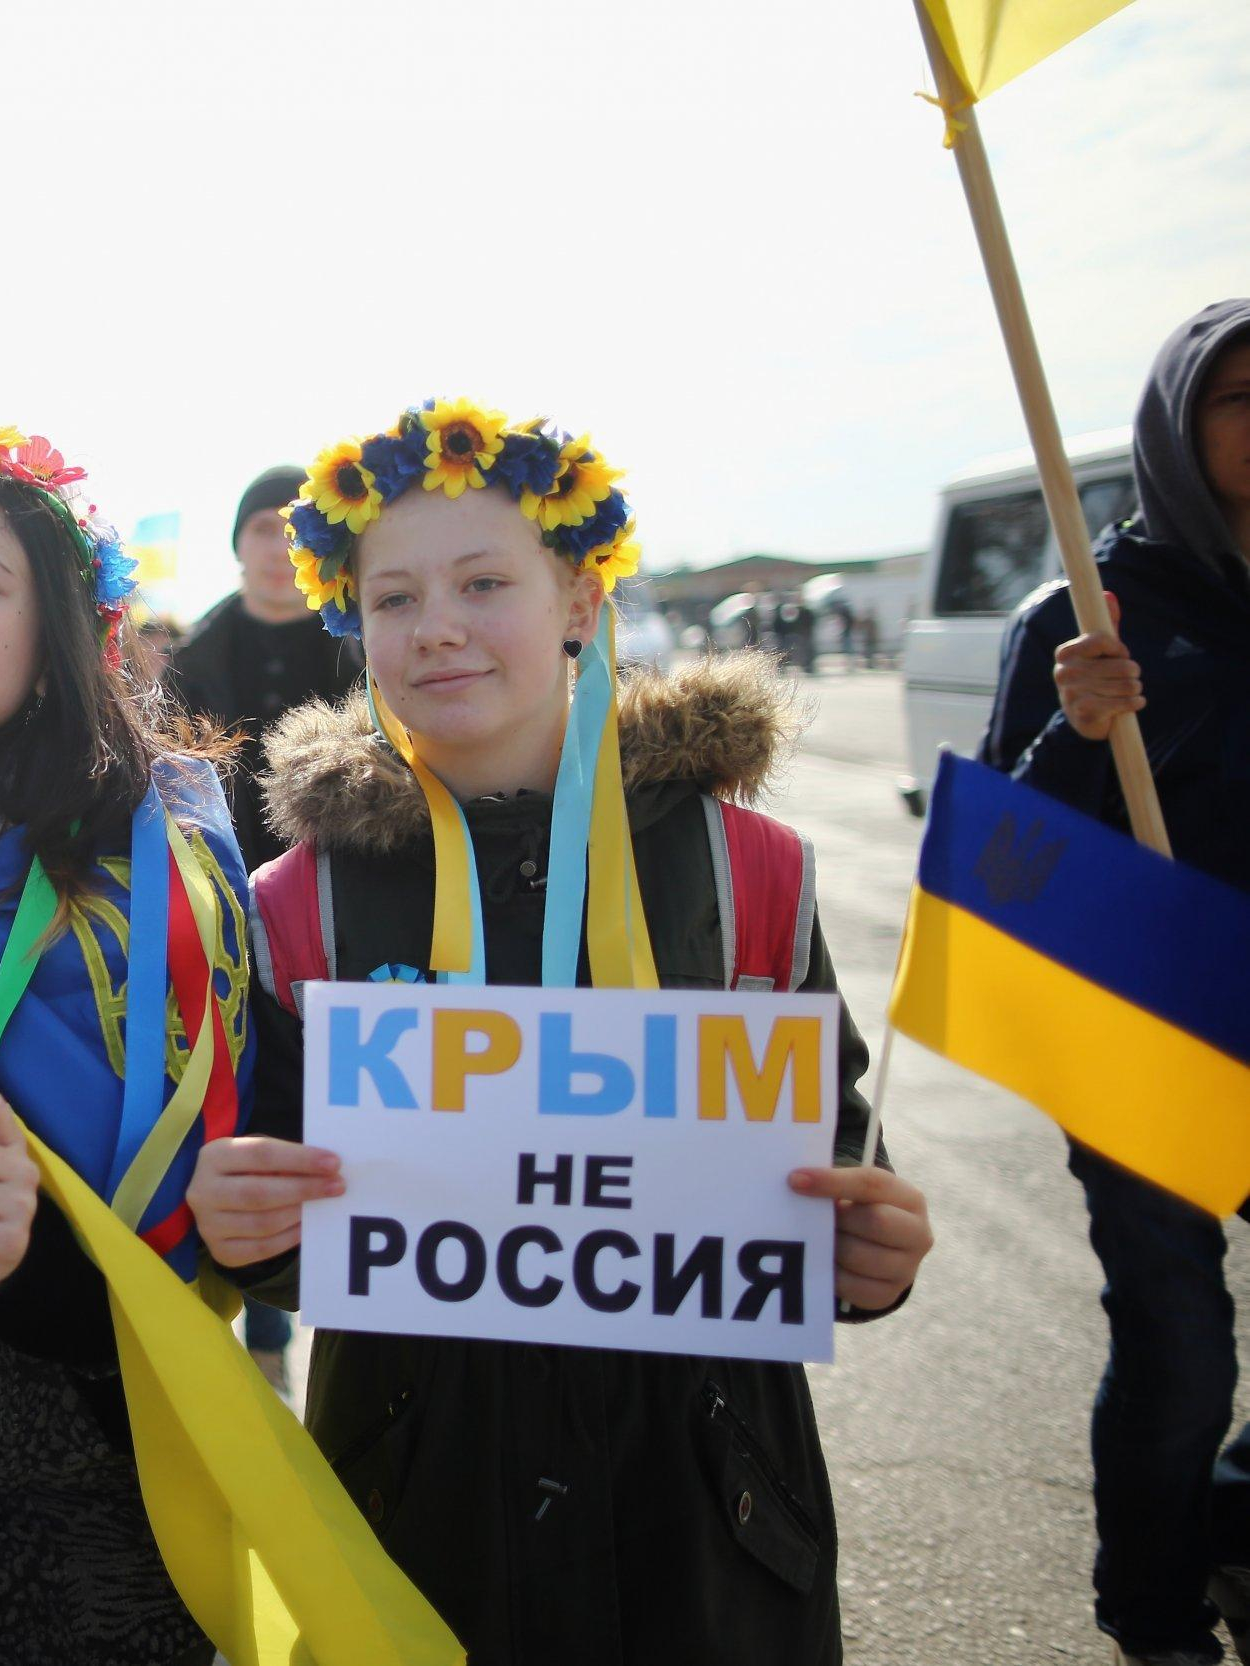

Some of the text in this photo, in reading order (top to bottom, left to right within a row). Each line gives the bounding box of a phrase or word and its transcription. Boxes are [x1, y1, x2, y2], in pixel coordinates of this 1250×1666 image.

[327, 1006, 822, 1123] КРЫМ
[516, 1152, 634, 1210] НЕ
[347, 1215, 806, 1326] РОССИЯ
